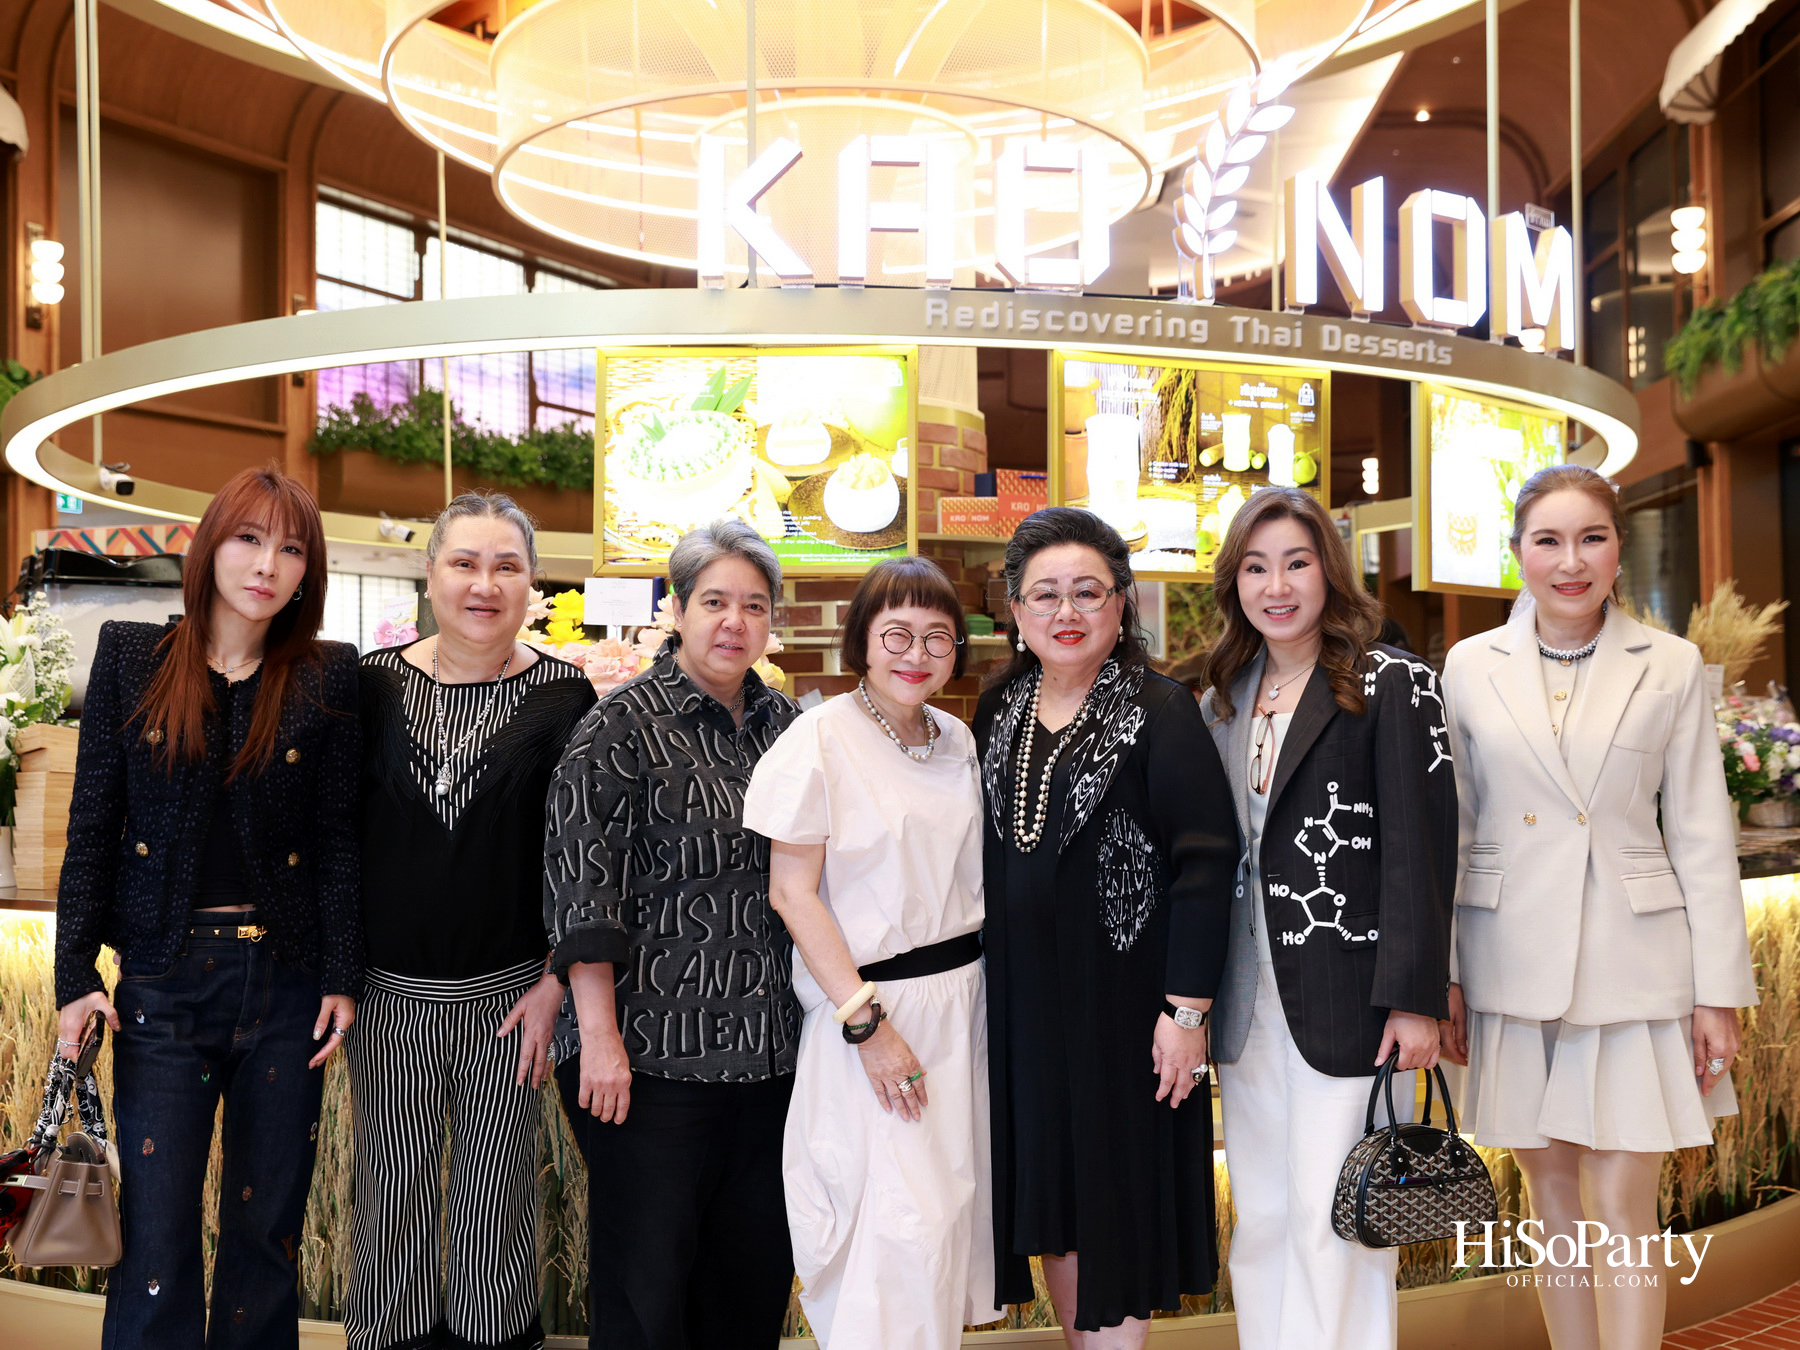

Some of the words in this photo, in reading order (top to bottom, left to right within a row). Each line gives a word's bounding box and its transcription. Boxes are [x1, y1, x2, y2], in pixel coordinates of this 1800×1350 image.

[1284, 174, 1576, 351] NOM
[925, 298, 1209, 344] Rediscovering
[1230, 316, 1303, 348] Thai
[1321, 323, 1453, 365] Desserts
[1010, 502, 1030, 512] KAO
[1351, 837, 1372, 850] OH
[1269, 883, 1290, 897] HO
[1282, 931, 1306, 946] HO
